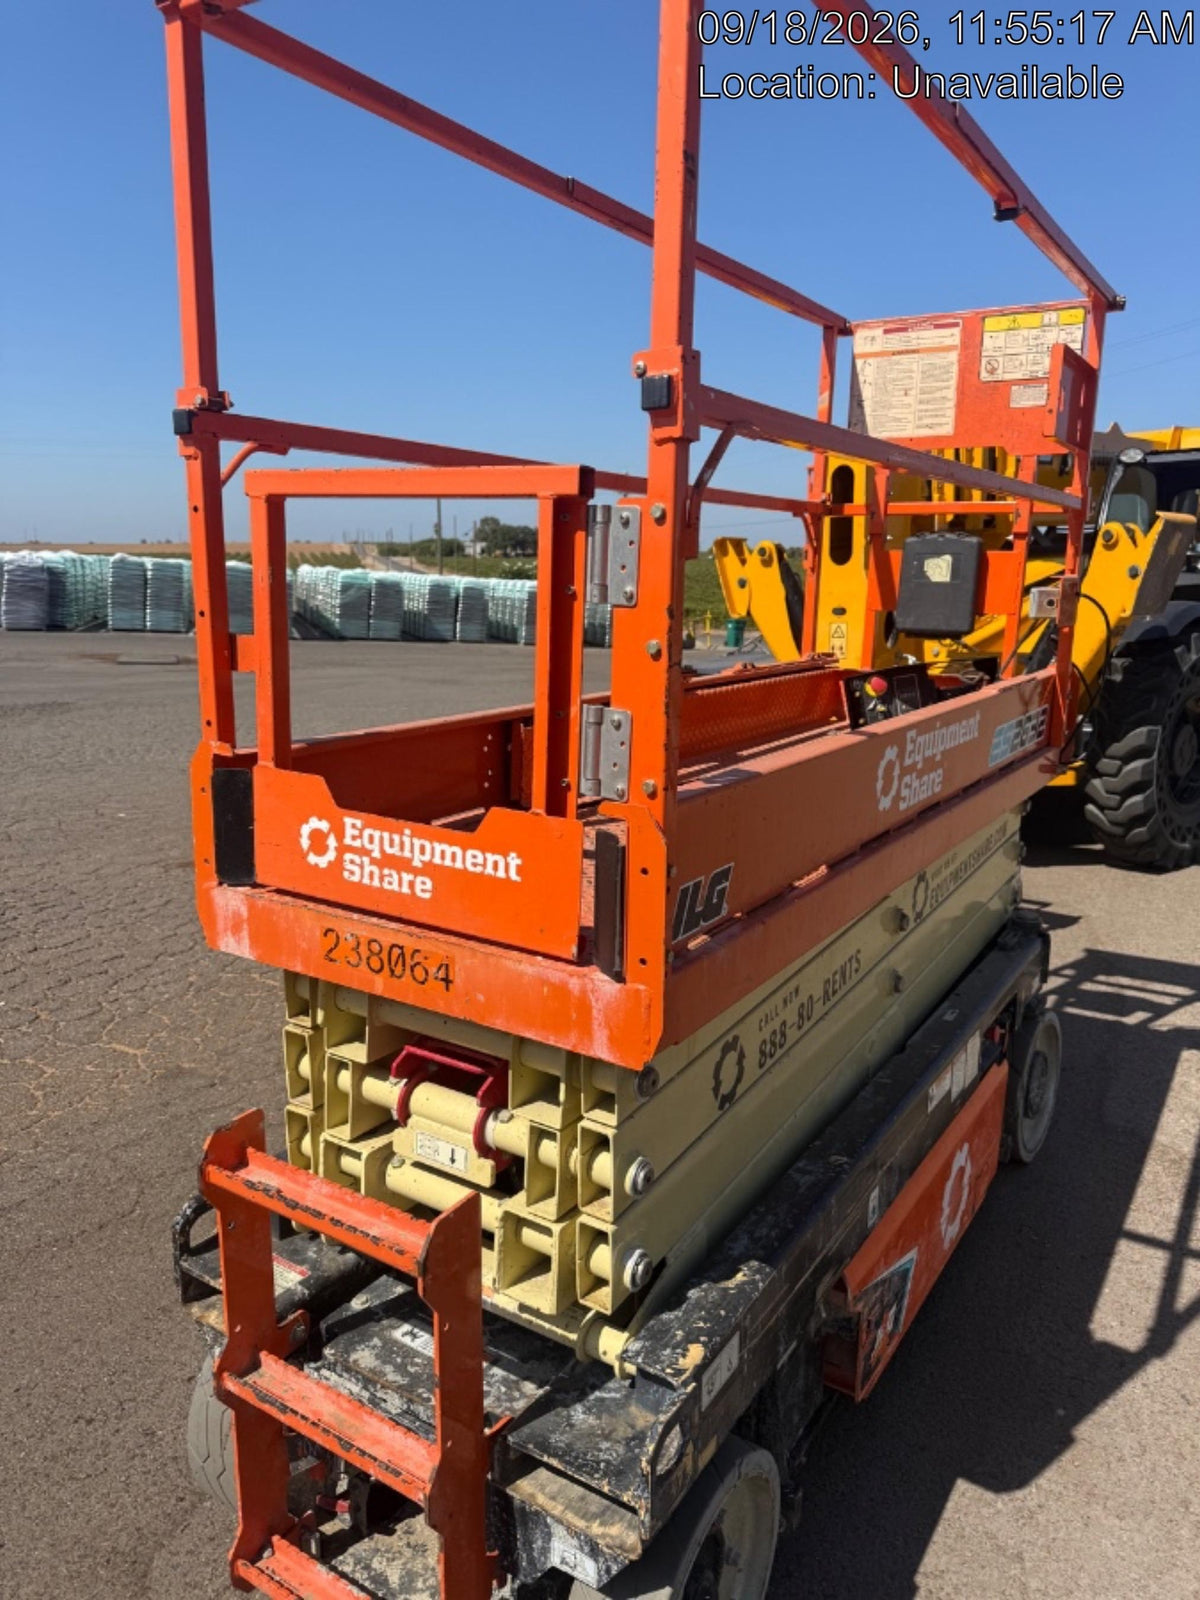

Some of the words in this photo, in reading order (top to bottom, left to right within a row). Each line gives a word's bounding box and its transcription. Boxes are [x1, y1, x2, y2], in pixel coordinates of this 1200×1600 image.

[903, 710, 980, 769] Equipment
[899, 768, 943, 811] Share
[342, 816, 522, 882] Equipment
[342, 852, 433, 899] Share
[671, 862, 735, 945] JLG
[321, 927, 455, 993] 238064
[758, 948, 862, 1070] 888-80-RENTS
